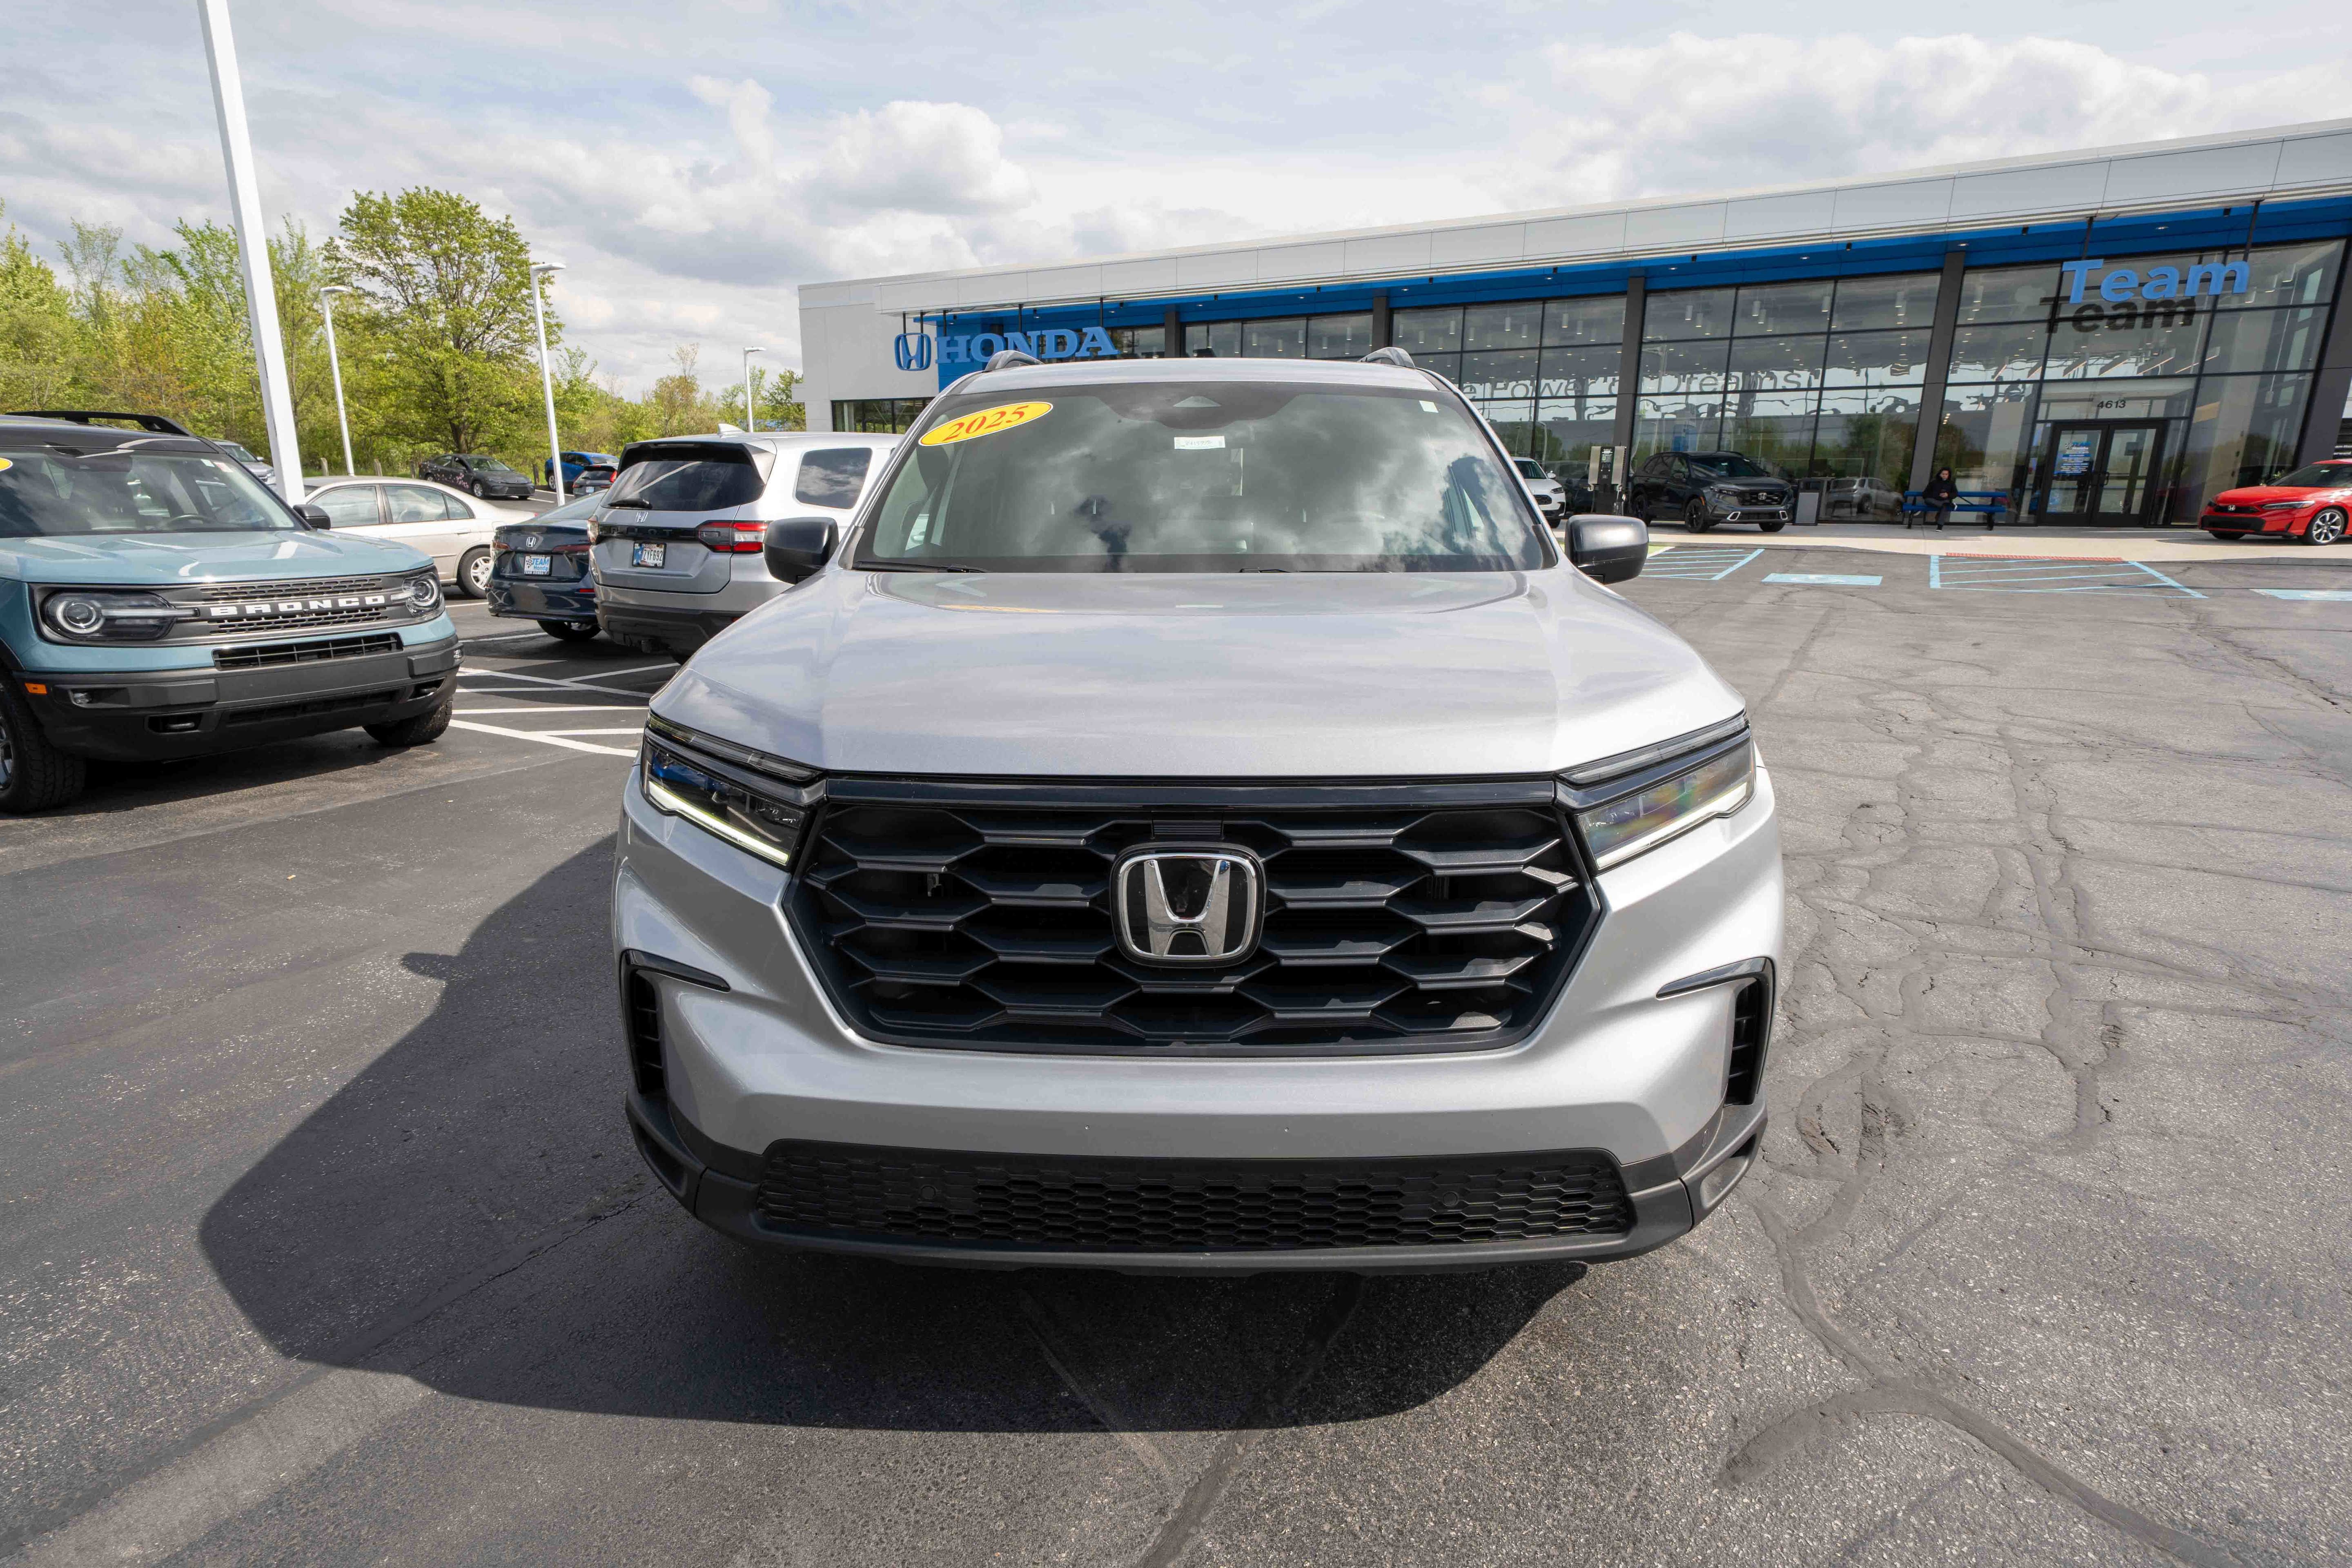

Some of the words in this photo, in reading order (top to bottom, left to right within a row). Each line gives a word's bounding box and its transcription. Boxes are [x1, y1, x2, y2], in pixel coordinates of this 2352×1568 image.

[2062, 259, 2250, 304] Team
[935, 327, 1120, 363] HONDA
[2097, 400, 2127, 409] 4613
[941, 405, 1029, 442] 2025
[643, 550, 663, 561] ZYF692
[210, 595, 385, 616] BRONCO
